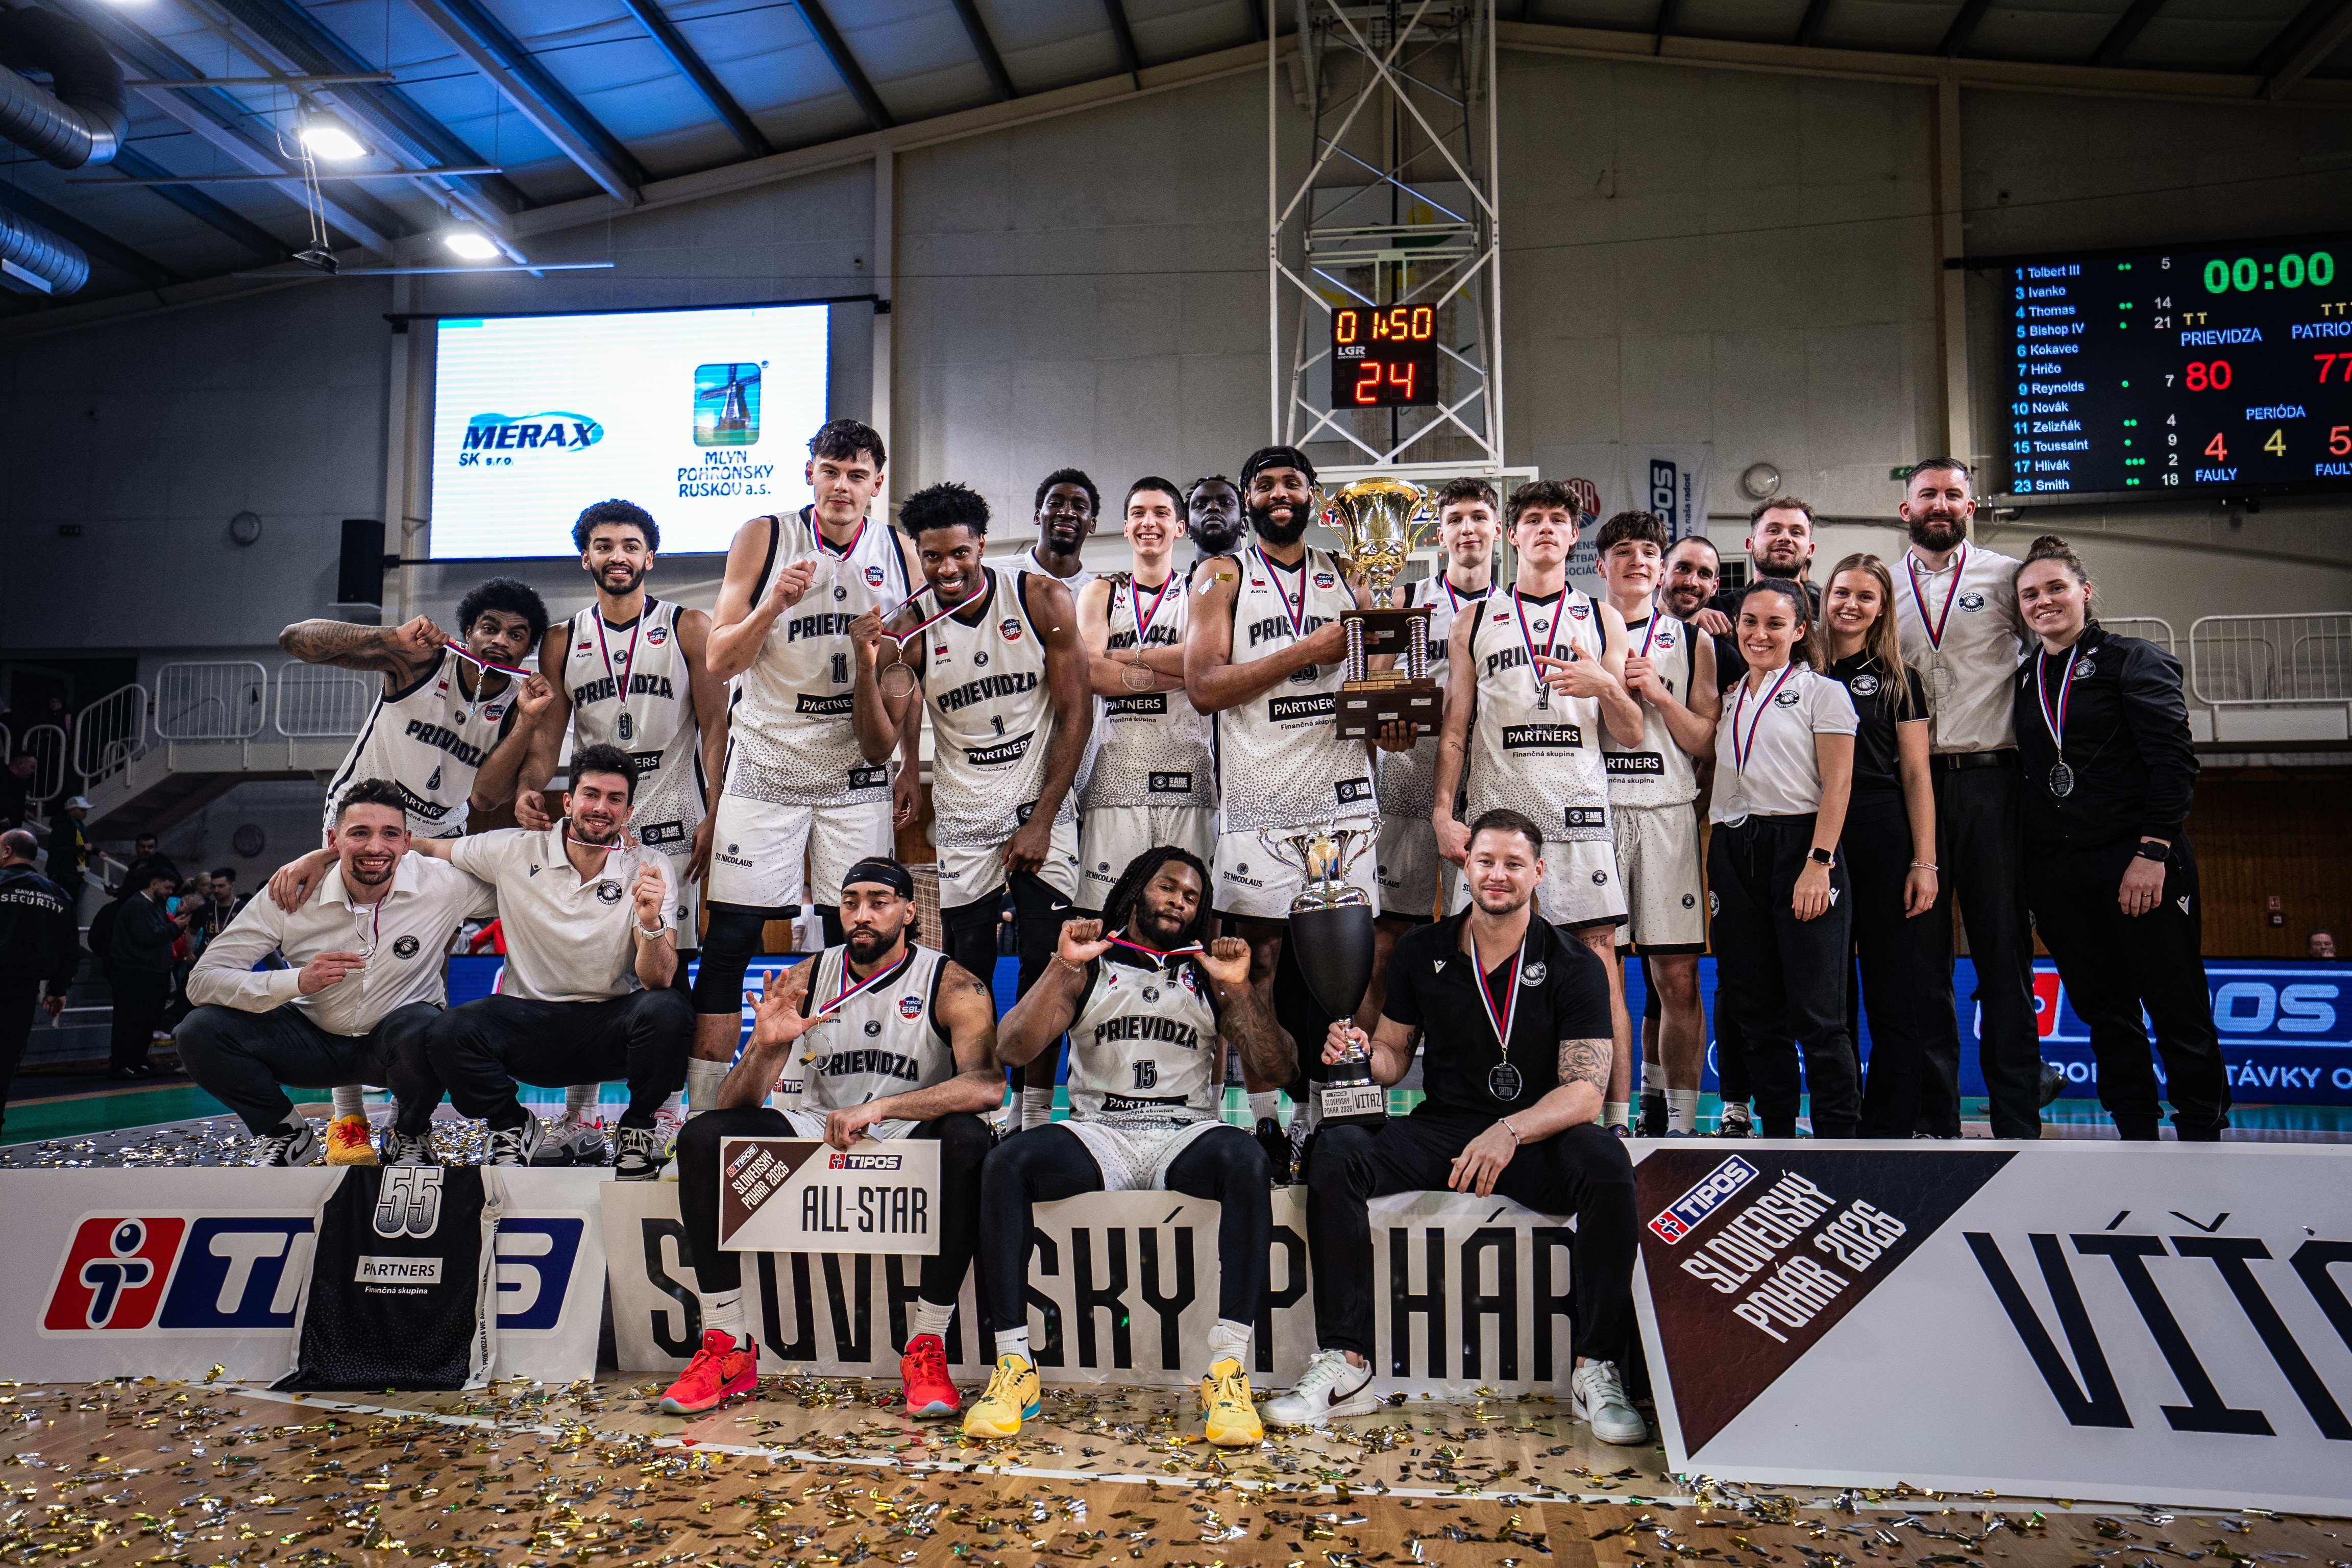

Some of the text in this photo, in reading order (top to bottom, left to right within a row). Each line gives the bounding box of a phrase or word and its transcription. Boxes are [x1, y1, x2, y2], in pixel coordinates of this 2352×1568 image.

[2161, 257, 2170, 270] 5
[2016, 264, 2080, 280] 1 Tolbert III
[2203, 252, 2334, 293] 00:00
[2016, 285, 2066, 300] 3 Ivanko
[2154, 296, 2172, 309] 14
[2016, 306, 2075, 318] 4 Thomas
[2017, 322, 2085, 337] 5 Bishop IV
[2154, 316, 2171, 329] 21
[2292, 321, 2352, 339] PATRIO
[2181, 327, 2263, 347] PRIEVIDZA
[1338, 346, 1365, 356] LGR
[2018, 344, 2026, 356] 6
[2018, 362, 2061, 376] 7 Hričo
[2186, 360, 2232, 391] 80
[1356, 361, 1413, 403] 24
[2019, 381, 2085, 396] 9 Reynolds
[2165, 375, 2174, 387] 7
[2012, 401, 2069, 415] 10 Novák
[2246, 403, 2306, 420] PERIÓDA
[2167, 413, 2176, 426] 4
[2014, 422, 2028, 434] 11
[462, 423, 598, 450] MERAX
[2168, 433, 2177, 446] 9
[2263, 429, 2286, 457] 4
[2329, 426, 2352, 456] 5
[2014, 439, 2089, 454] 15 Toussaint
[2204, 432, 2227, 461] 4
[458, 453, 480, 466] SK
[705, 451, 747, 464] MLYN
[2169, 453, 2178, 466] 2
[2015, 459, 2070, 473] 17 Hlivák
[2315, 462, 2352, 476] FAUL
[2162, 473, 2179, 486] 18
[2195, 467, 2238, 482] FAULY
[679, 482, 771, 497] RUSKOV a.s.
[2015, 479, 2069, 493] 23 Smith
[1004, 620, 1019, 628] TIPOS
[1004, 628, 1021, 637] SBL
[831, 652, 848, 683] 11
[936, 671, 1038, 714] PRIEVIDZA
[1275, 698, 1336, 715] PARTNER
[618, 712, 633, 740] 9
[990, 715, 1006, 737] 1
[1281, 721, 1313, 730] Finančná
[1508, 730, 1579, 743] PARTNERS
[721, 853, 753, 868] NICOLAUS
[601, 881, 620, 890] PRIEVIDZA
[1091, 872, 1119, 885] NICOLAU
[1230, 873, 1264, 887] NICOLAUS
[1, 894, 64, 913] SECURITY
[598, 895, 620, 904] BASKETBALL
[397, 936, 416, 944] PRIEVIDZA
[396, 949, 418, 959] BASKETBALL
[1094, 1015, 1198, 1050] PRIEVIDZA
[1133, 1060, 1157, 1089] 15
[1340, 1105, 1353, 1113] 2026
[734, 1145, 757, 1171] TIPOS
[849, 1156, 898, 1169] TIPOS
[731, 1148, 775, 1195] SLOVENSKÝ
[741, 1160, 790, 1211] POHÁR 2026
[1676, 1161, 1749, 1218] TIPOS
[373, 1165, 445, 1239] 55
[802, 1185, 927, 1234] ALL-STAR
[1679, 1168, 1837, 1294] SLOVENSKÝ
[363, 1263, 435, 1277] PARTNERS
[1732, 1198, 1907, 1344] POHÁR 2026
[364, 1285, 397, 1294] Finančná
[480, 1335, 488, 1366] PRIEVIDZA
